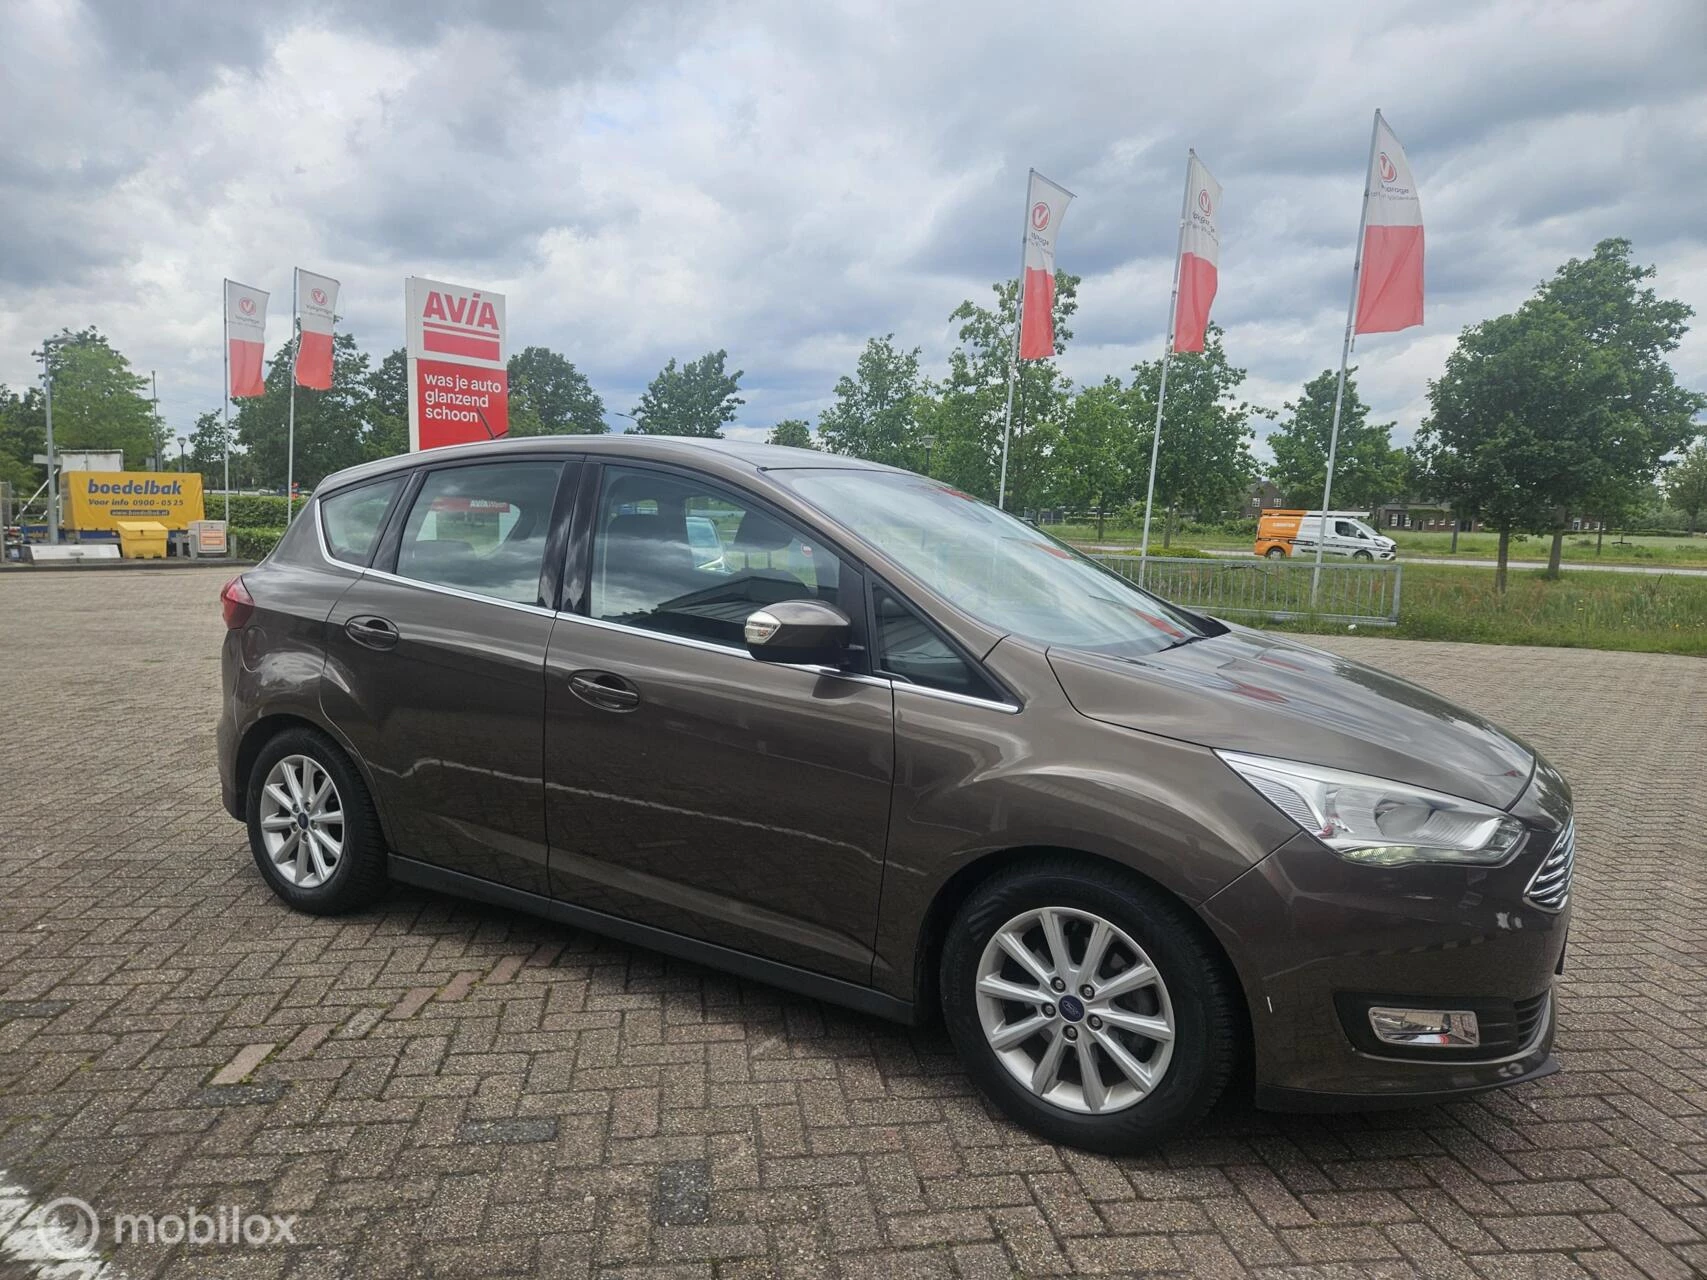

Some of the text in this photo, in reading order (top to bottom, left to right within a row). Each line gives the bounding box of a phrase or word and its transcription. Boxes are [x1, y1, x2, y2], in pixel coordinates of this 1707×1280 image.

[424, 374, 501, 393] was je auto
[425, 389, 489, 408] glanzend
[425, 406, 478, 423] schoon
[88, 479, 182, 495] boedelbak
[88, 498, 109, 506] Voor
[112, 498, 129, 506] info
